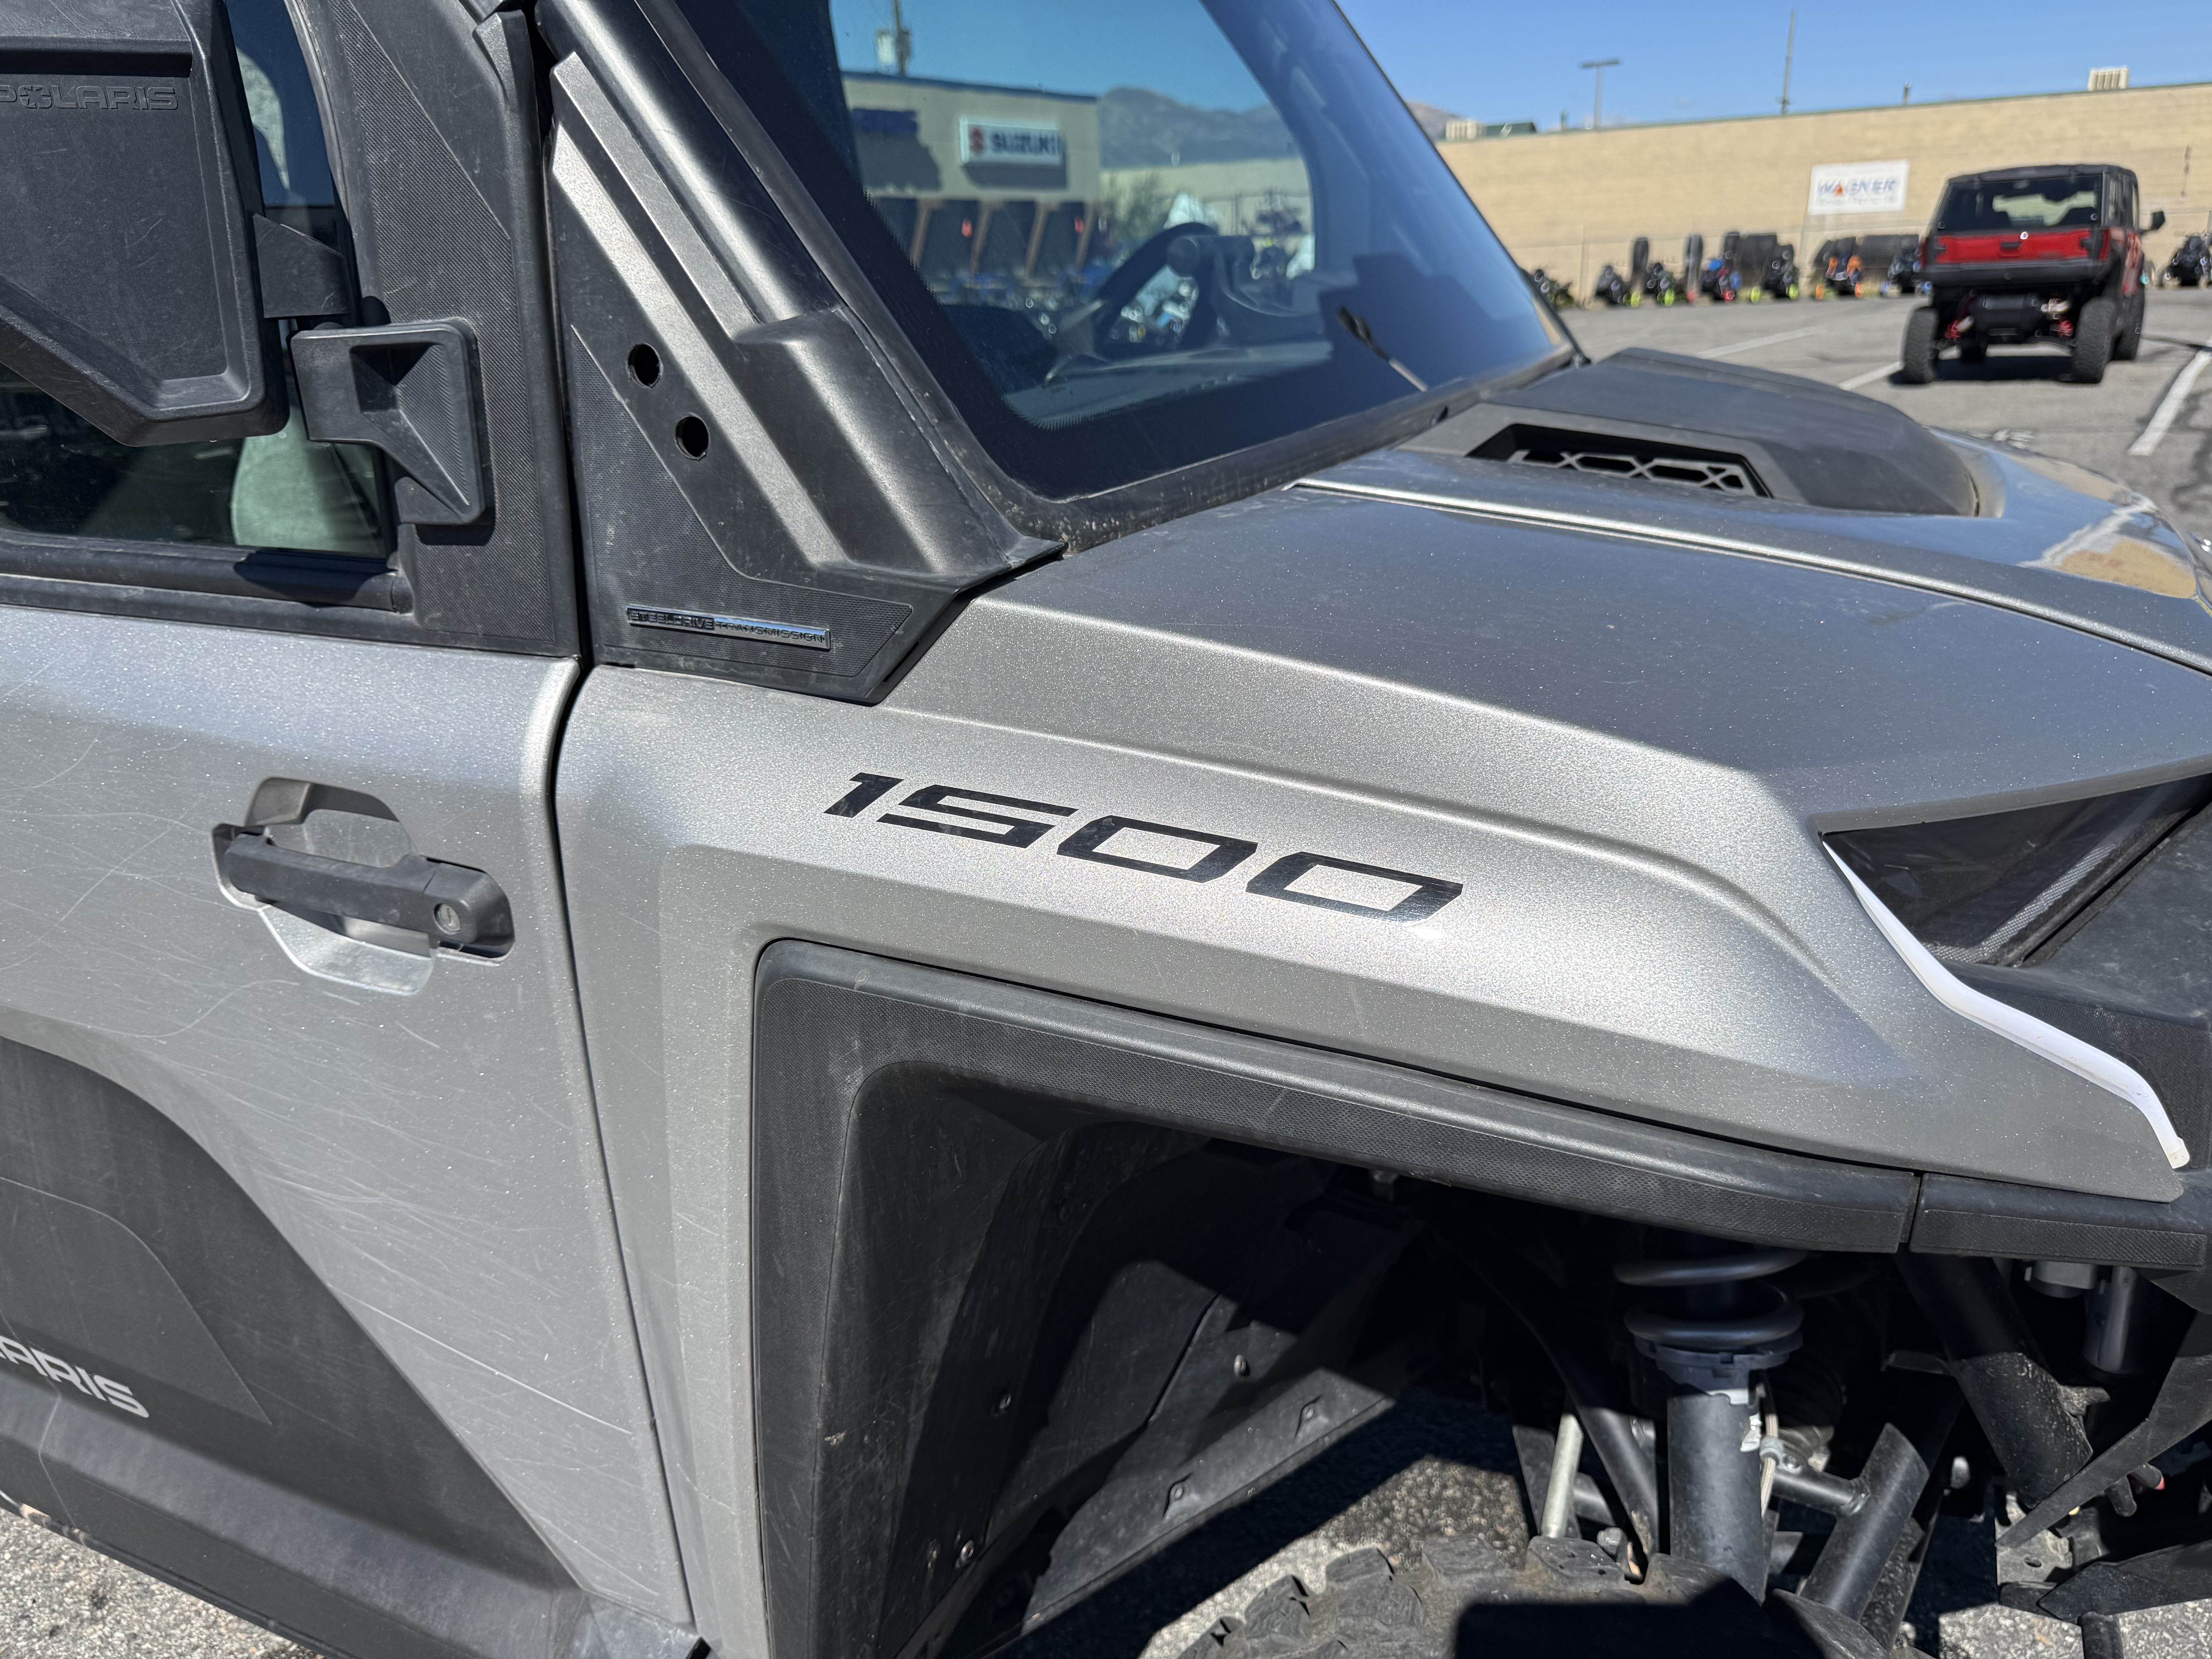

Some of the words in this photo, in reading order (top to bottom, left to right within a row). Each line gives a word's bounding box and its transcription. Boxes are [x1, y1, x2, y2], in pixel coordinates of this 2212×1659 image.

[991, 132, 1062, 155] SUZUKI
[1818, 177, 1896, 195] WAGNER
[716, 620, 826, 643] TRANSMISSION
[824, 772, 1463, 924] 1500
[0, 1335, 149, 1418] ARIS
